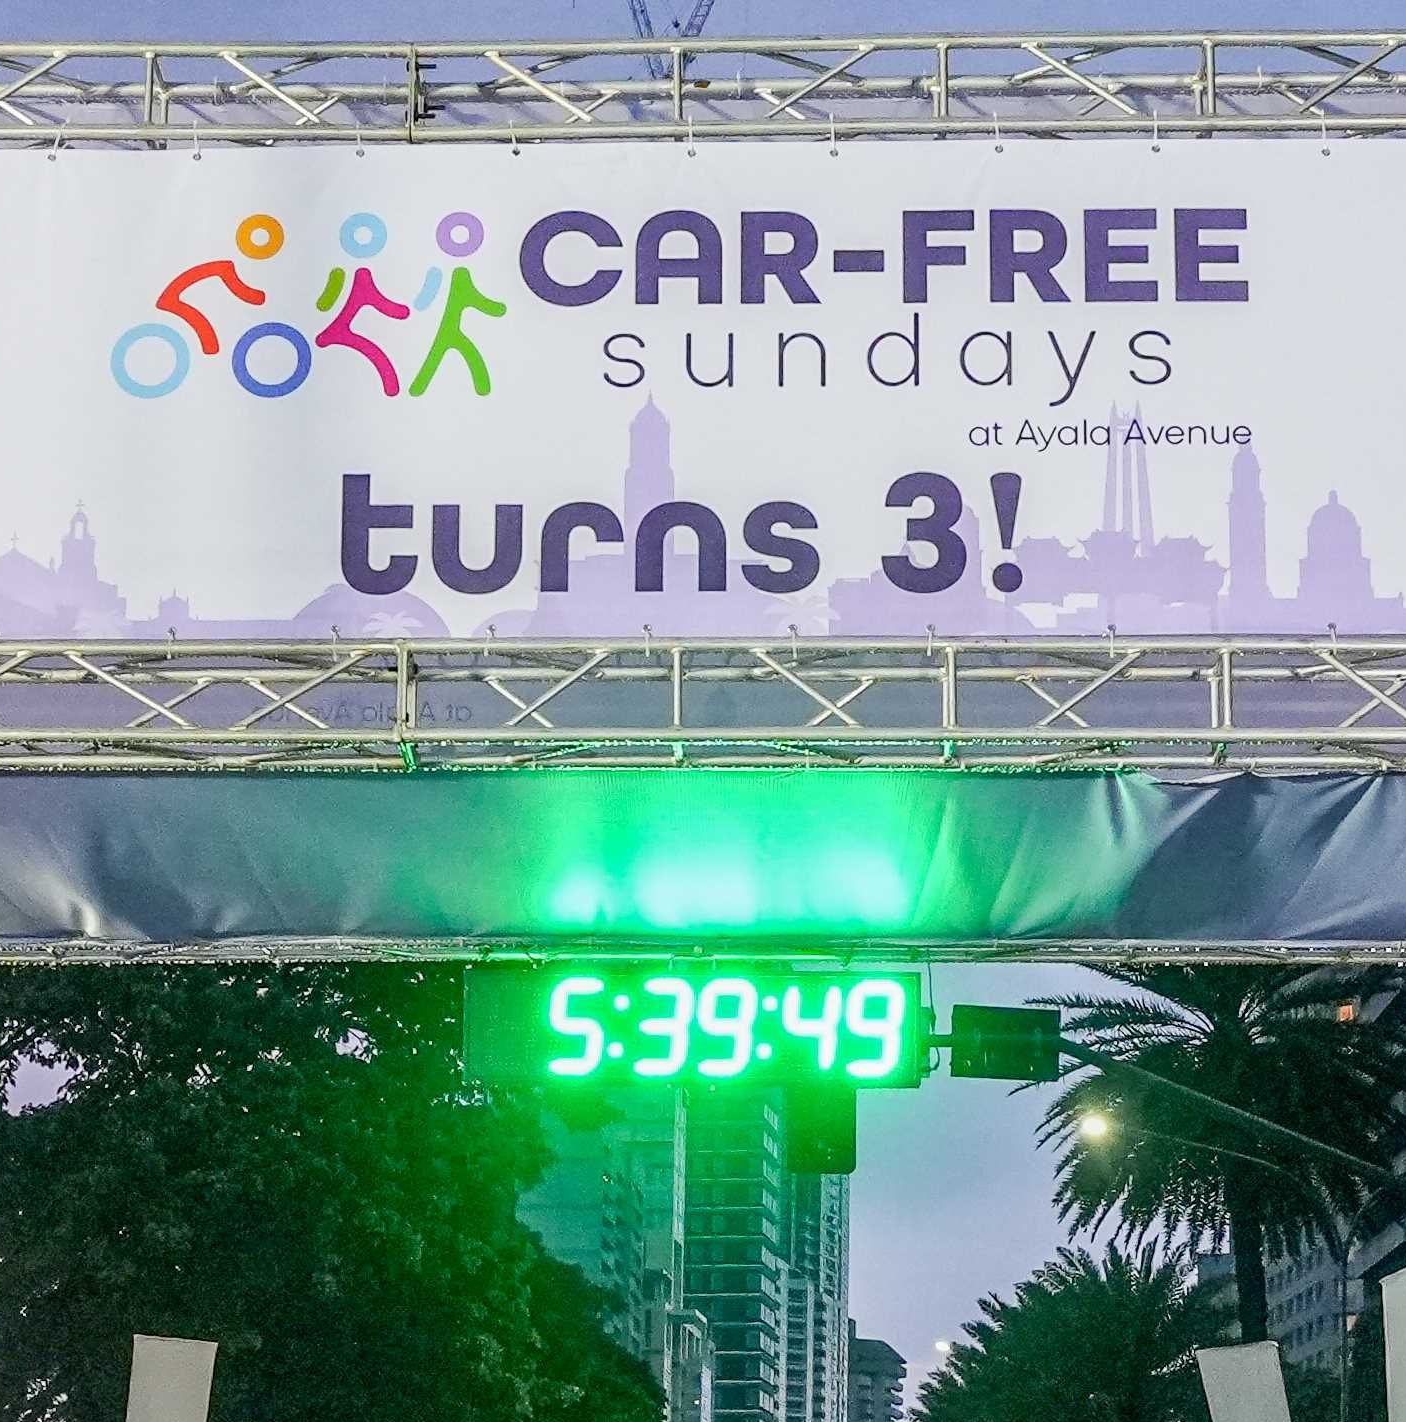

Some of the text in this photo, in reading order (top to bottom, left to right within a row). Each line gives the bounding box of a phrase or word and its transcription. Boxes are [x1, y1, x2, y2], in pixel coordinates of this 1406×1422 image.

[519, 208, 1249, 307] CAR-FREE
[603, 313, 1172, 407] sundays
[969, 418, 1252, 454] at Ayala Avenue
[340, 471, 1023, 595] turns 3!
[548, 977, 906, 1078] 5:39:49
